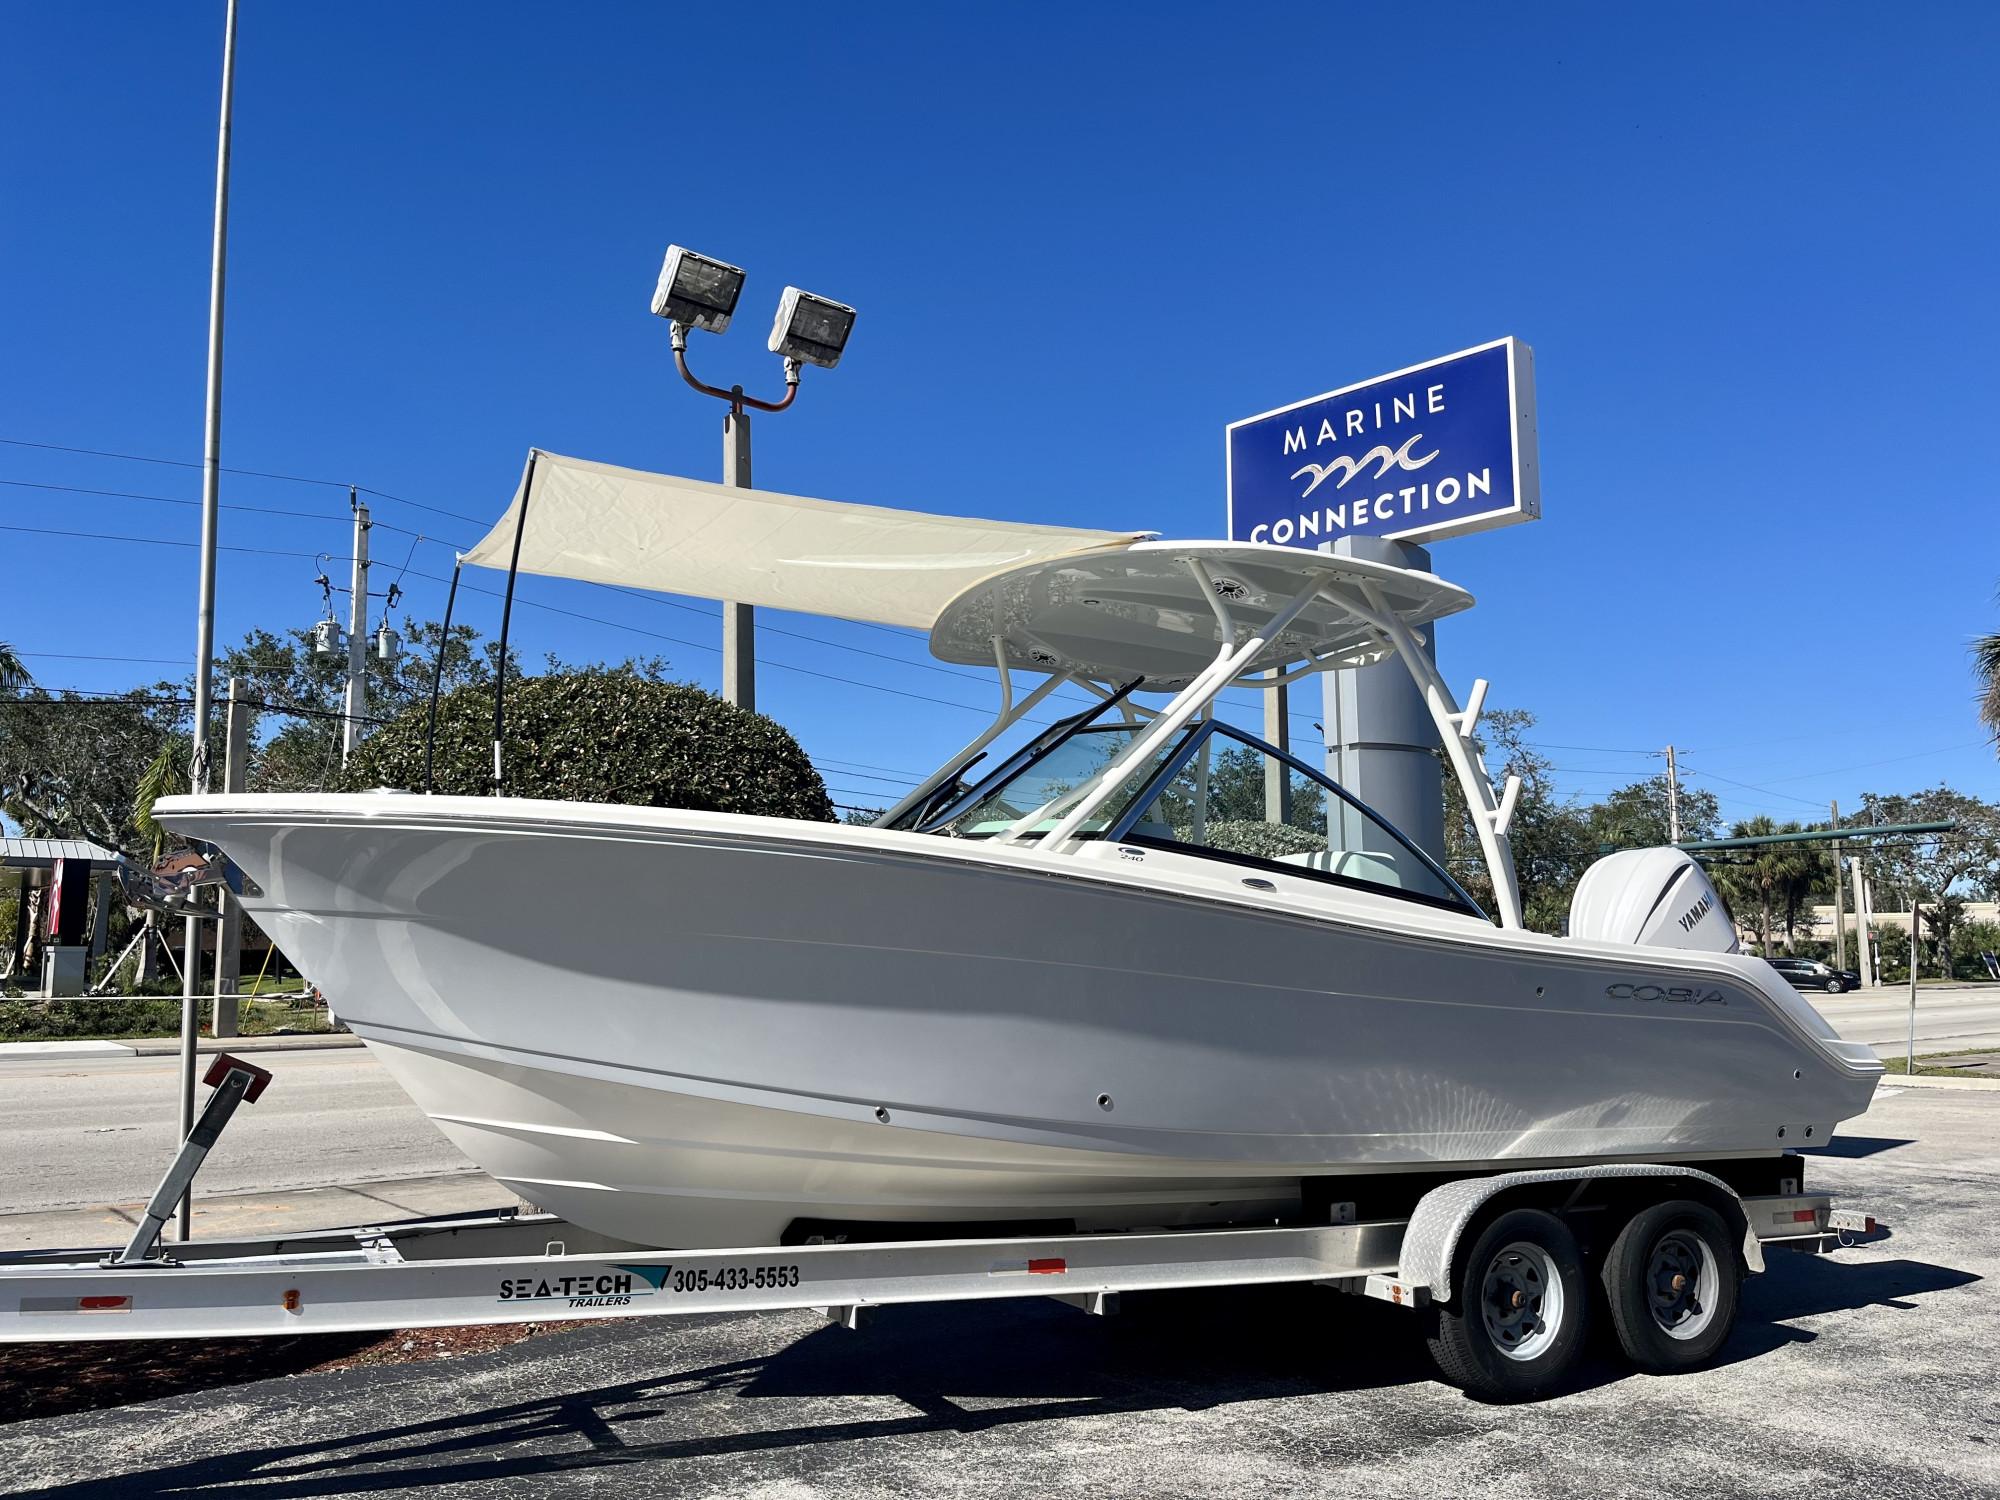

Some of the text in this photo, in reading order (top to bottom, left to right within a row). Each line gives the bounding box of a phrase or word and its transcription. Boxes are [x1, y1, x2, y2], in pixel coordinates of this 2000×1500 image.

[1283, 384, 1445, 455] MARINE
[1250, 468, 1490, 545] CONNECTION
[1120, 854, 1144, 862] 240
[1605, 983, 1729, 1006] COBIA
[500, 1274, 632, 1299] SEA-TECH
[673, 1265, 799, 1293] 305-433-5553
[568, 1296, 632, 1308] TRAILERS
